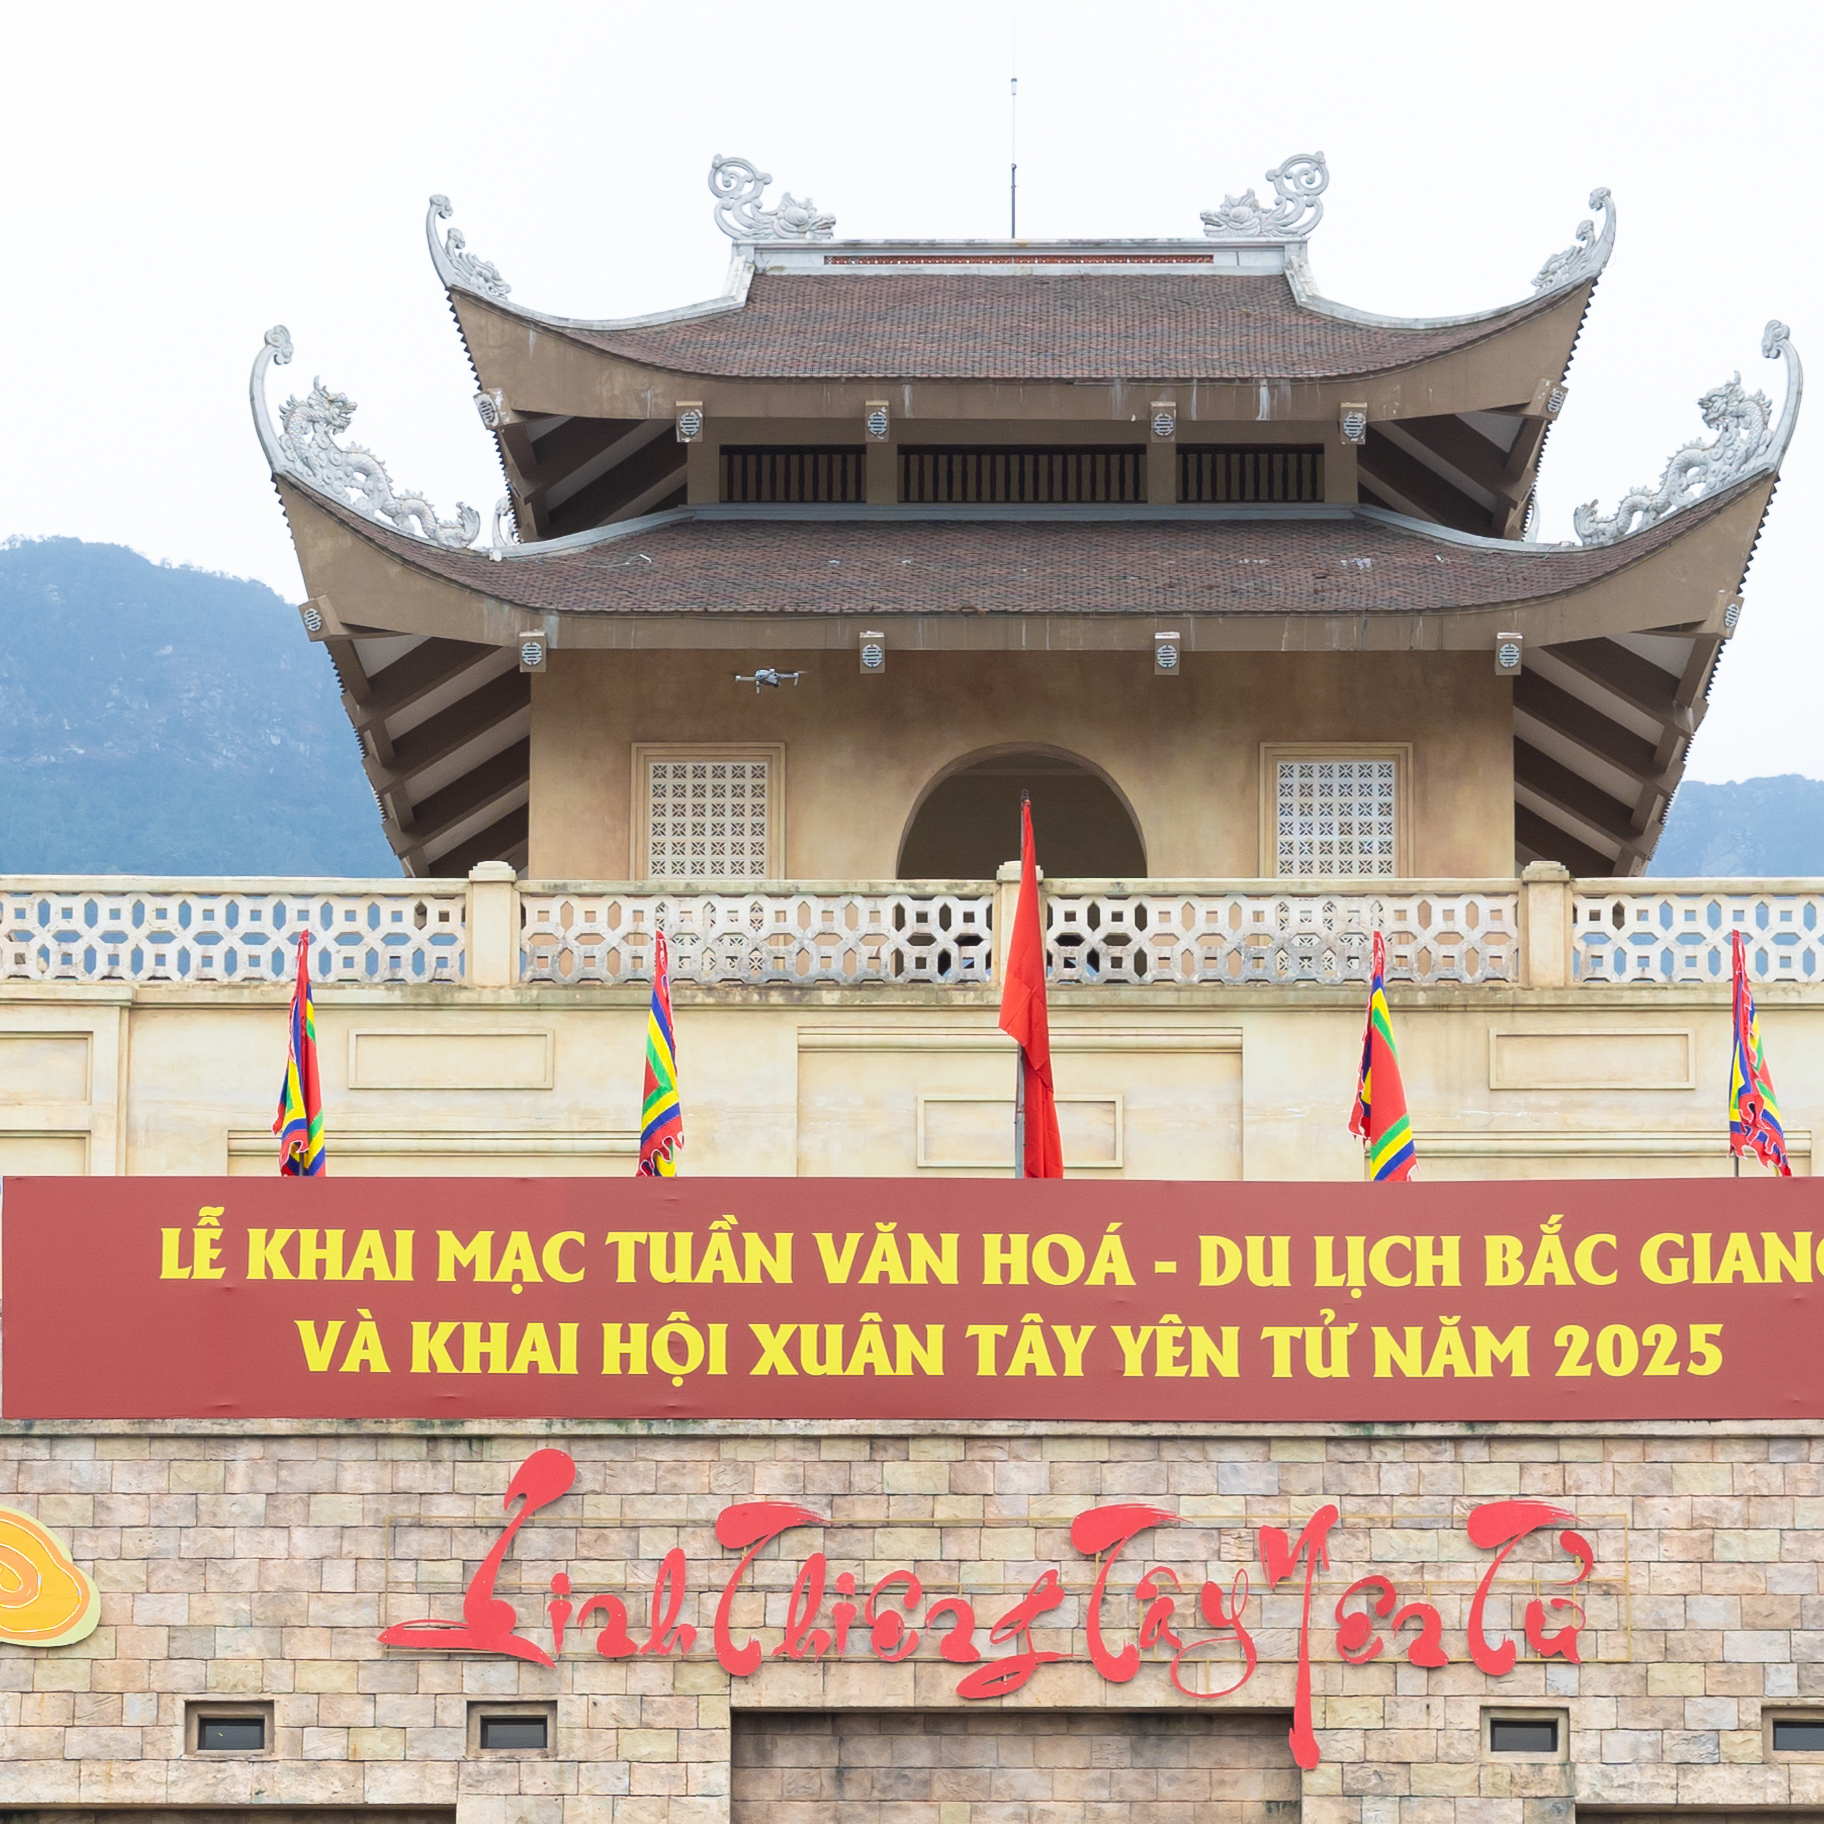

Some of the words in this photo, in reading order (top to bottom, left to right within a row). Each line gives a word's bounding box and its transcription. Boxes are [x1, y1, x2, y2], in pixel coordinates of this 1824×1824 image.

[159, 1206, 226, 1280] LỄ
[246, 1228, 416, 1281] KHAI
[435, 1229, 585, 1295] MẠC
[605, 1214, 794, 1284] TUẦN
[811, 1221, 959, 1285] VĂN
[982, 1222, 1136, 1286] HOÁ
[1198, 1235, 1292, 1287] DU
[1314, 1234, 1462, 1298] LỊCH
[1484, 1214, 1618, 1287] BẮC
[294, 1308, 391, 1373] VÀ
[410, 1321, 580, 1375] KHAI
[601, 1311, 729, 1388] HỘI
[749, 1312, 945, 1376] XUÂN
[965, 1312, 1097, 1377] TÂY
[1111, 1313, 1240, 1378] YÊN
[1260, 1308, 1359, 1378] TỬ
[1373, 1315, 1531, 1378] NĂM
[1553, 1323, 1723, 1377] 2025
[376, 1448, 698, 1669] Linh
[1070, 1503, 1258, 1699] Tây
[1466, 1499, 1594, 1676] Tử
